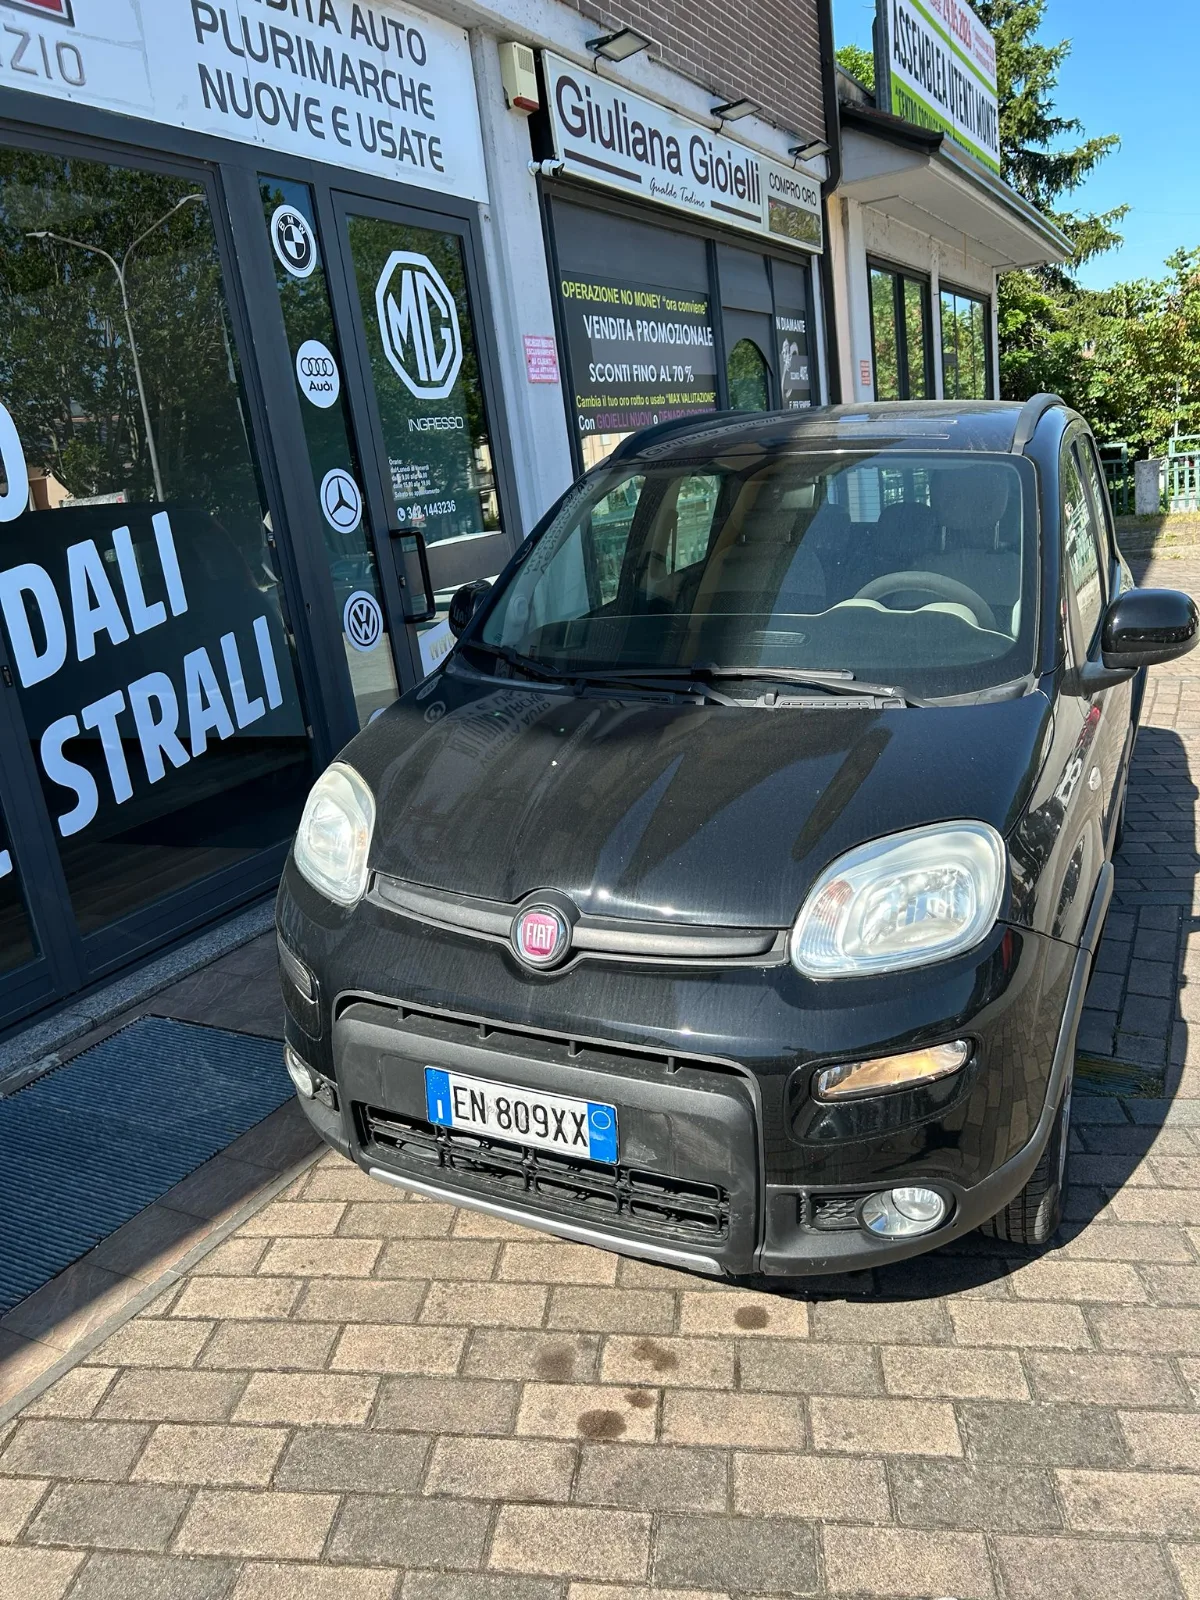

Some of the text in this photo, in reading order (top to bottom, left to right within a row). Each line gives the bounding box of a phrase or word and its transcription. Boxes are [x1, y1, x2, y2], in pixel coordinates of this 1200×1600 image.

[350, 3, 427, 67] AUTO
[0, 22, 86, 87] ZIO
[190, 0, 436, 120] PLURIMARCHE
[892, 0, 948, 109] ASSEMBLEA
[947, 60, 976, 135] UTENTI
[197, 63, 446, 173] NUOVE E USATE
[554, 73, 762, 206] Giuliana Gioielli
[649, 177, 706, 208] Gualdo Tadino
[768, 171, 818, 207] COMPRO ORO
[278, 214, 307, 236] BMW
[561, 280, 620, 304] OPERAZIONE
[620, 289, 634, 306] NO
[634, 291, 661, 309] MONEY
[582, 314, 714, 347] VENDITA PROMOZIONALE
[308, 381, 334, 393] Audi
[588, 362, 695, 383] SCONTI FINO AL 70 %
[575, 395, 602, 408] Cambia
[602, 395, 608, 407] il
[607, 396, 619, 407] tuo
[619, 396, 630, 406] oro
[650, 395, 666, 405] usato
[407, 416, 464, 432] INGRESSO
[578, 414, 596, 431] Con
[596, 412, 630, 430] GIOIELLI
[629, 411, 653, 428] NUOVI
[653, 414, 659, 425] o
[40, 614, 284, 837] STRALI
[525, 922, 555, 950] FIAT
[452, 1084, 488, 1126] EN
[495, 1096, 589, 1148] 809XX
